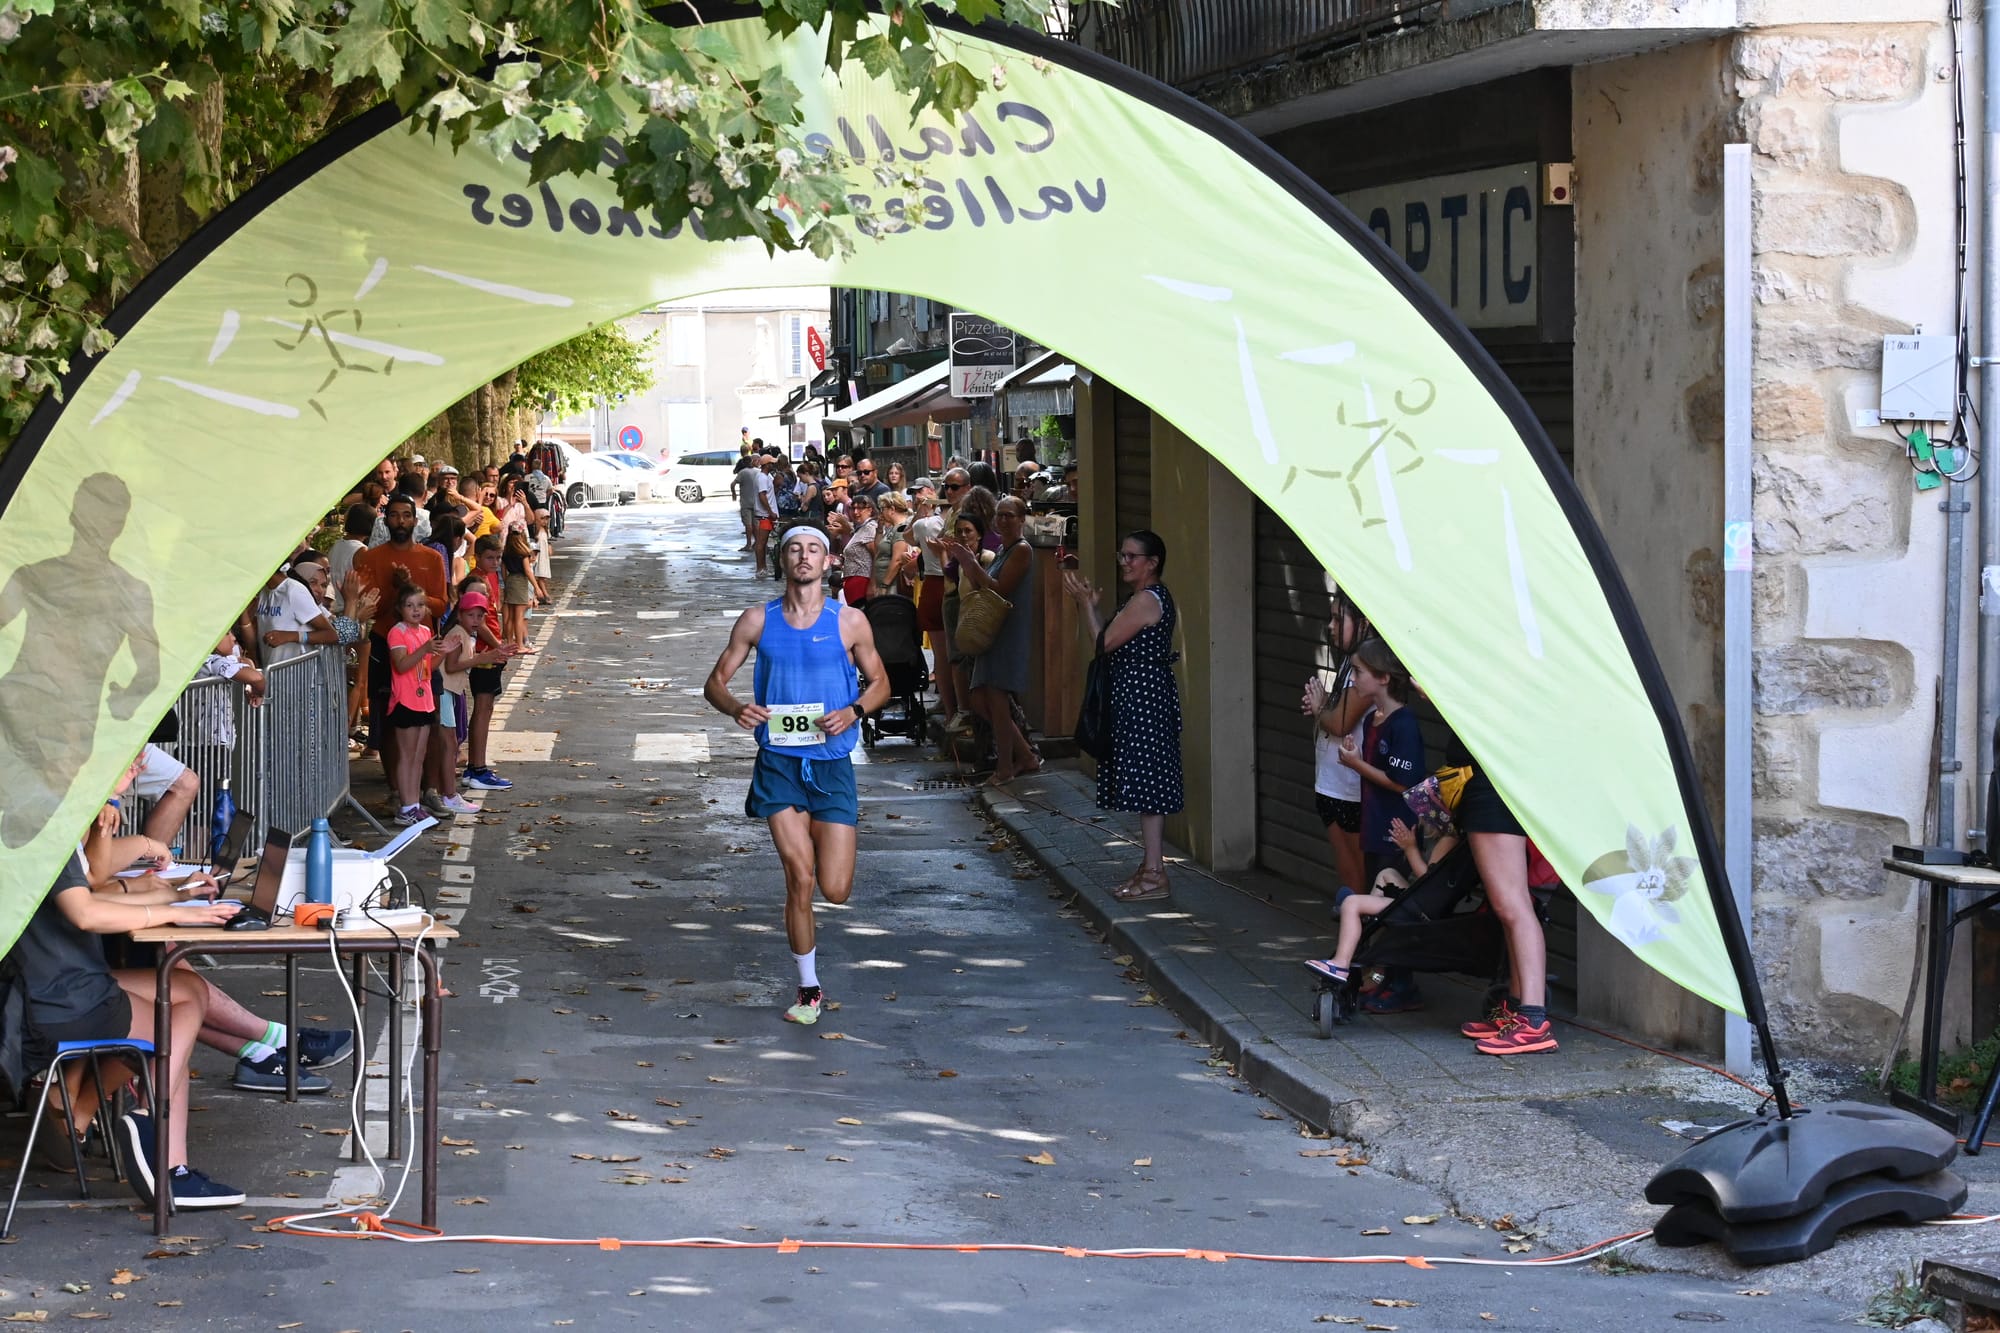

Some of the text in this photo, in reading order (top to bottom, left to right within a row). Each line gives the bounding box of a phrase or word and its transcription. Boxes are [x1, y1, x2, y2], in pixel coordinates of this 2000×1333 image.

[954, 320, 1009, 335] Pizzeria
[809, 333, 823, 363] TABAC
[984, 370, 1004, 383] Petit
[782, 716, 809, 732] 98
[1388, 755, 1413, 771] QNB
